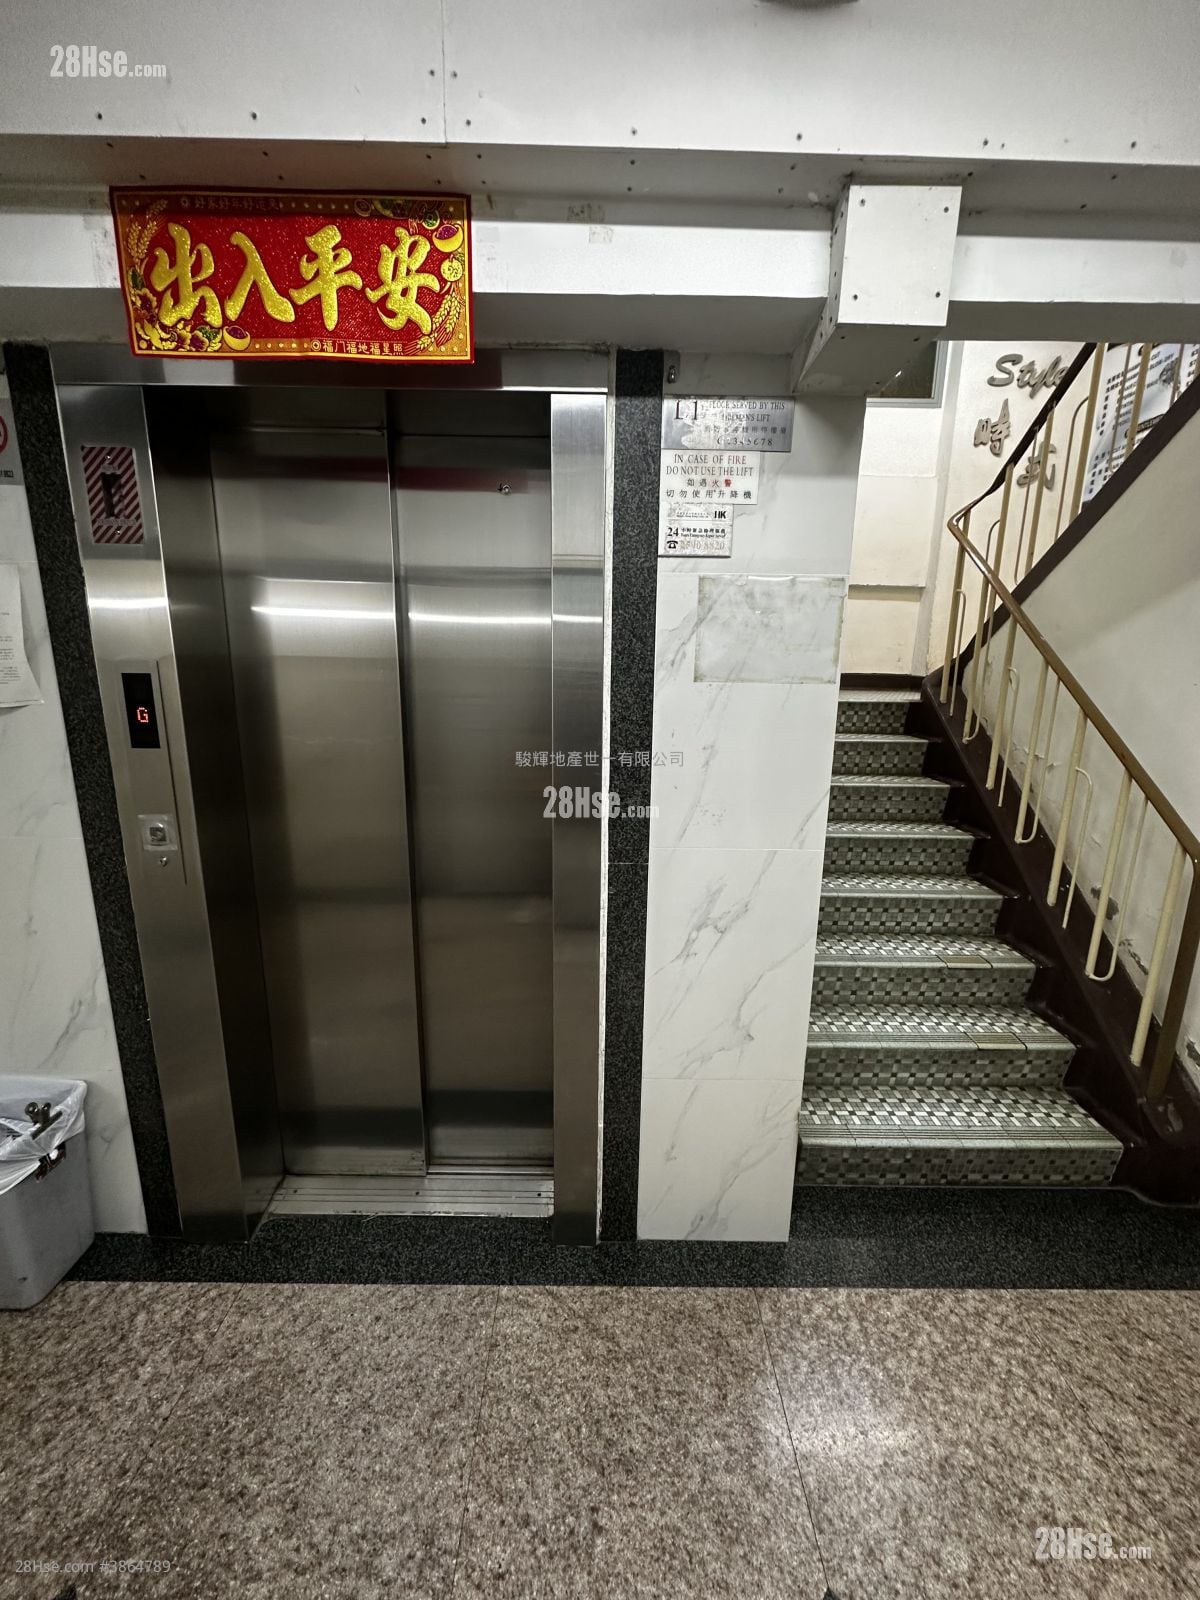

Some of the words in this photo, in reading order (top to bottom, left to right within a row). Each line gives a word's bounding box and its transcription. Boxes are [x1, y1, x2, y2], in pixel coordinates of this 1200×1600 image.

[150, 222, 440, 335] 出入平安
[759, 402, 769, 410] BY
[771, 402, 785, 410] THIS
[756, 414, 771, 422] LIFT
[674, 453, 684, 464] IN
[687, 454, 709, 464] CASE
[712, 454, 724, 464] OF
[727, 455, 747, 465] FIRE
[666, 465, 679, 475] DO
[680, 466, 700, 475] NOT
[700, 466, 716, 476] USE
[718, 466, 734, 476] THE
[736, 466, 754, 477] LIFT
[687, 478, 732, 487] 如遇火警
[666, 489, 752, 499] 切勿使用升降機
[667, 527, 679, 537] 24
[137, 707, 149, 722] G
